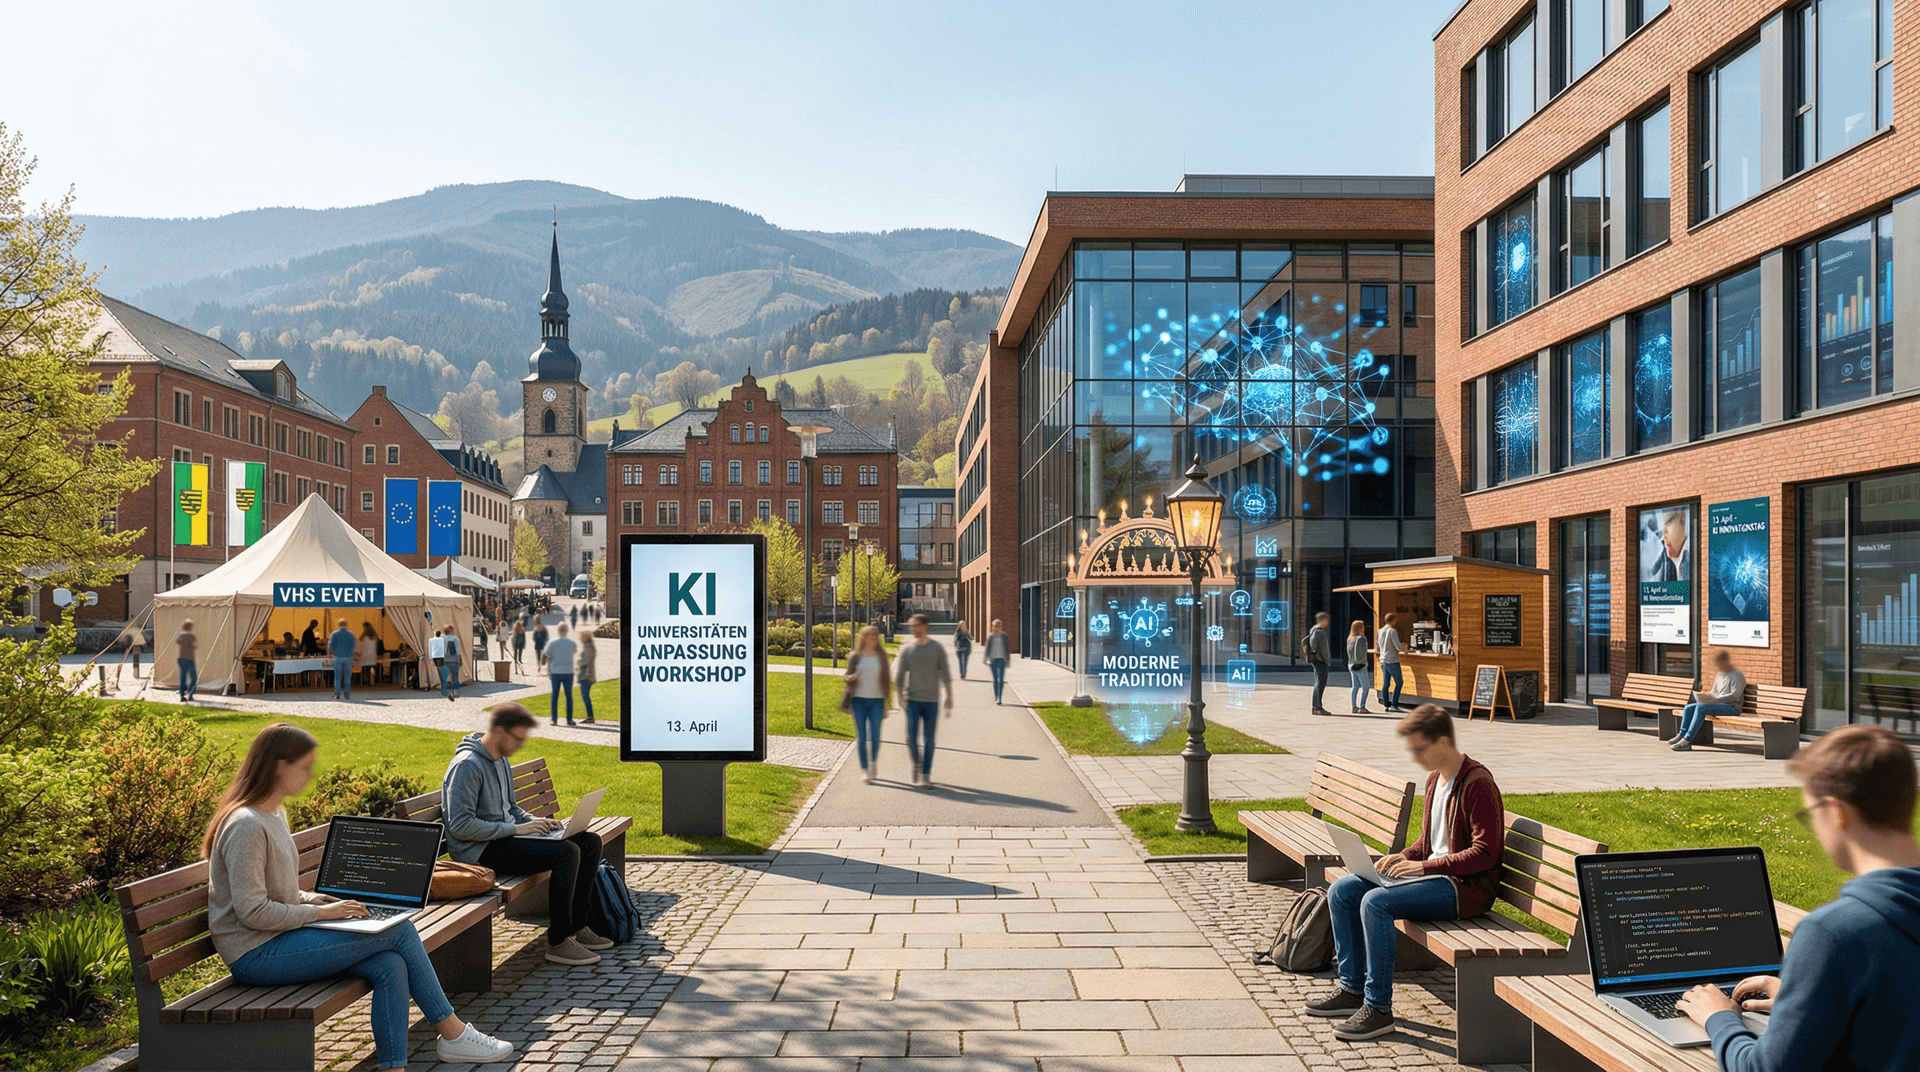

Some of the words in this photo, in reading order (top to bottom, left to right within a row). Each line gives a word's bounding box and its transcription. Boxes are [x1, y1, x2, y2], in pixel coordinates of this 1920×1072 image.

[279, 587, 315, 603] VHS
[321, 587, 377, 603] EVENT
[668, 572, 716, 616] KI
[637, 622, 747, 639] UNIVERSITÄTEN
[637, 644, 747, 660] ANPASSUNG
[1103, 656, 1180, 670] MODERNE
[638, 666, 747, 683] WORKSHOP
[1098, 672, 1184, 687] TRADITION
[666, 720, 685, 733] 13.
[689, 720, 718, 735] April
